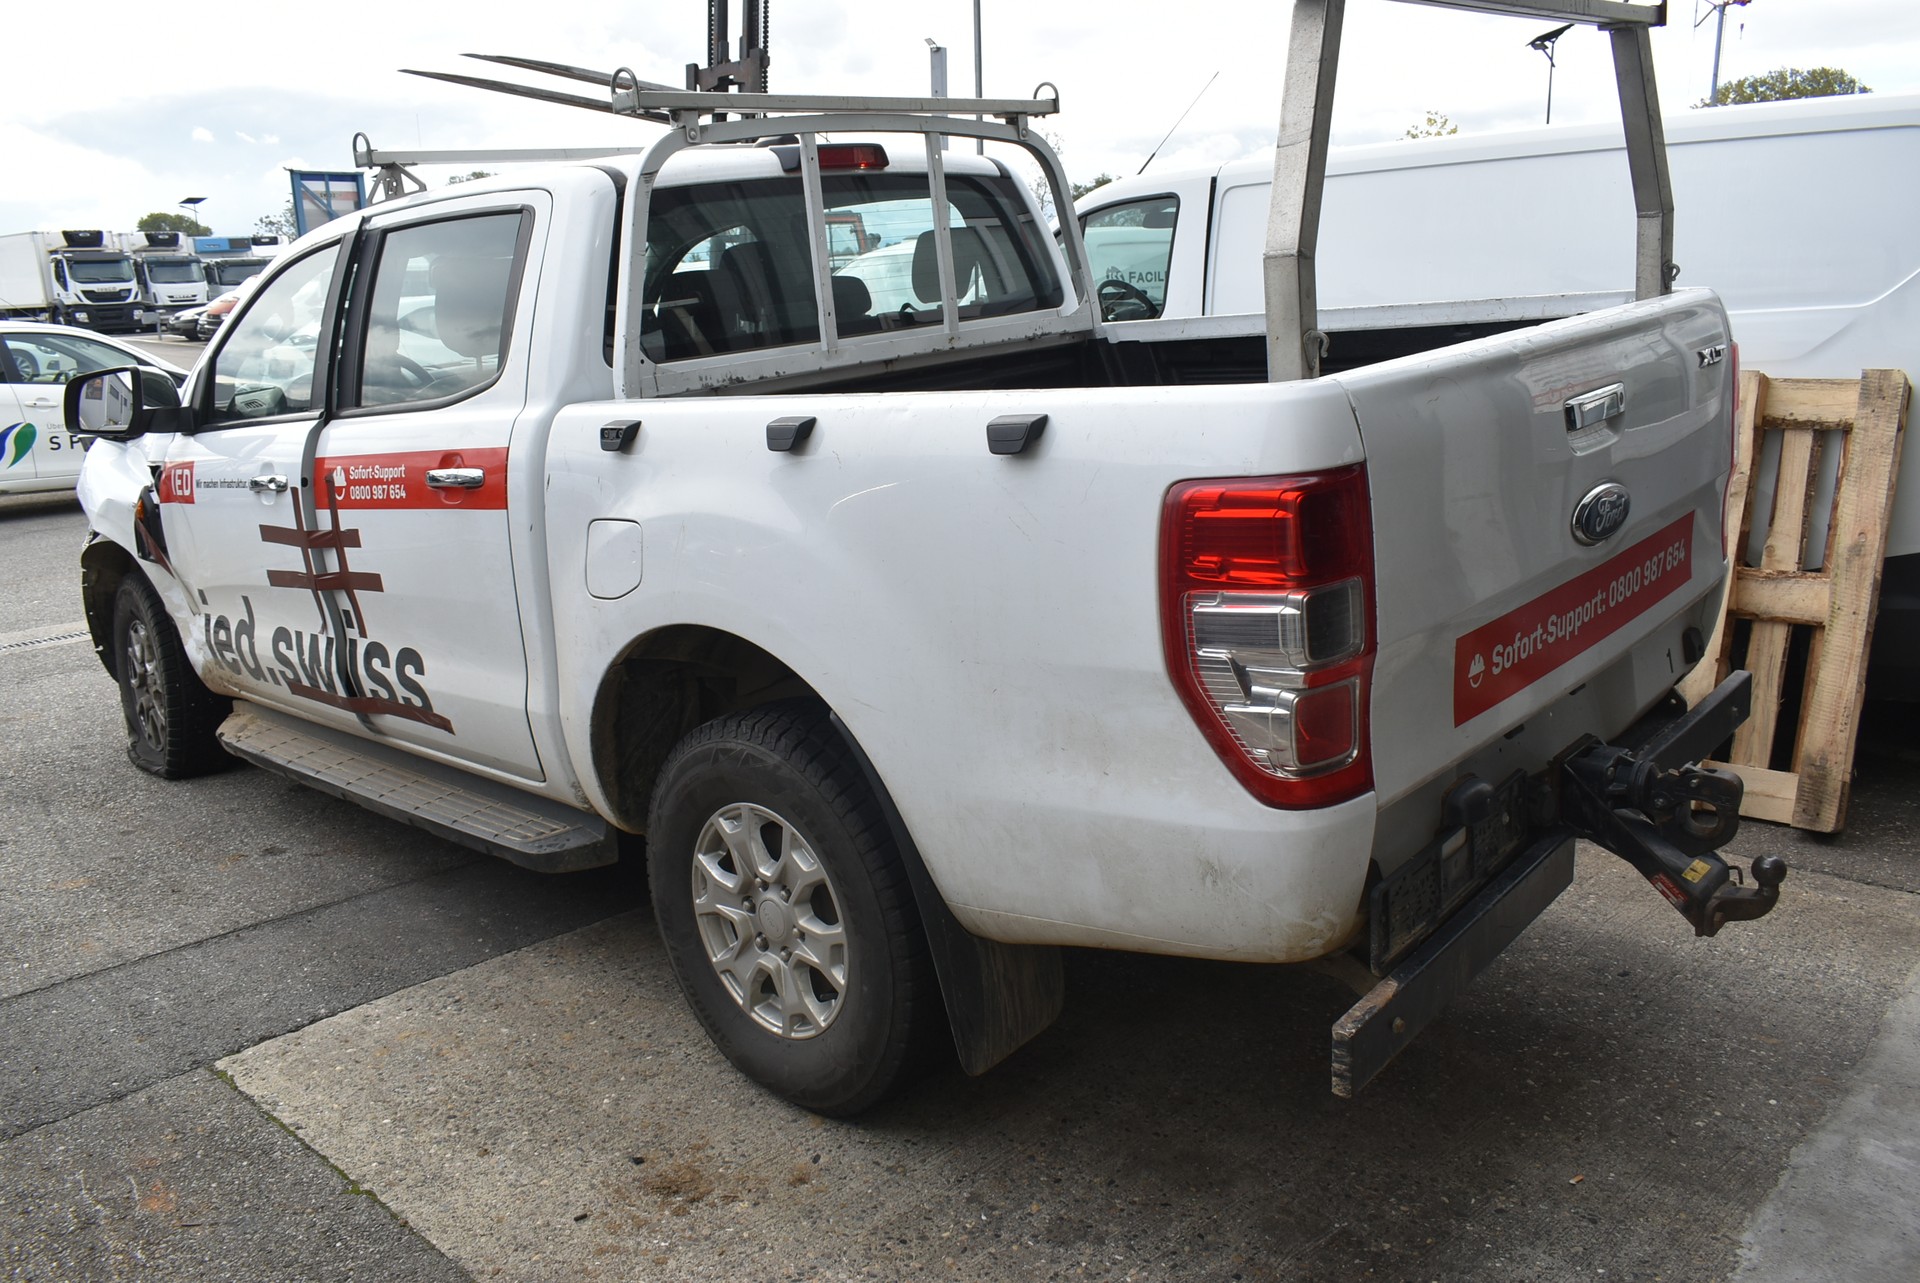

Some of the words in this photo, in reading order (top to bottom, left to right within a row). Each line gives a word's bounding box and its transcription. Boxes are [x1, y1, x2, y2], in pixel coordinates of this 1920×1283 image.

[171, 468, 191, 496] IED
[203, 479, 219, 488] machen
[349, 464, 406, 481] Sofort-Support
[350, 485, 371, 499] 0800
[372, 484, 388, 499] 987
[389, 484, 406, 499] 654
[1596, 494, 1625, 532] Ford
[1492, 588, 1607, 675] Sofort-Support:
[1609, 566, 1641, 608] 0800
[1643, 549, 1665, 586] 987
[1666, 538, 1686, 571] 654
